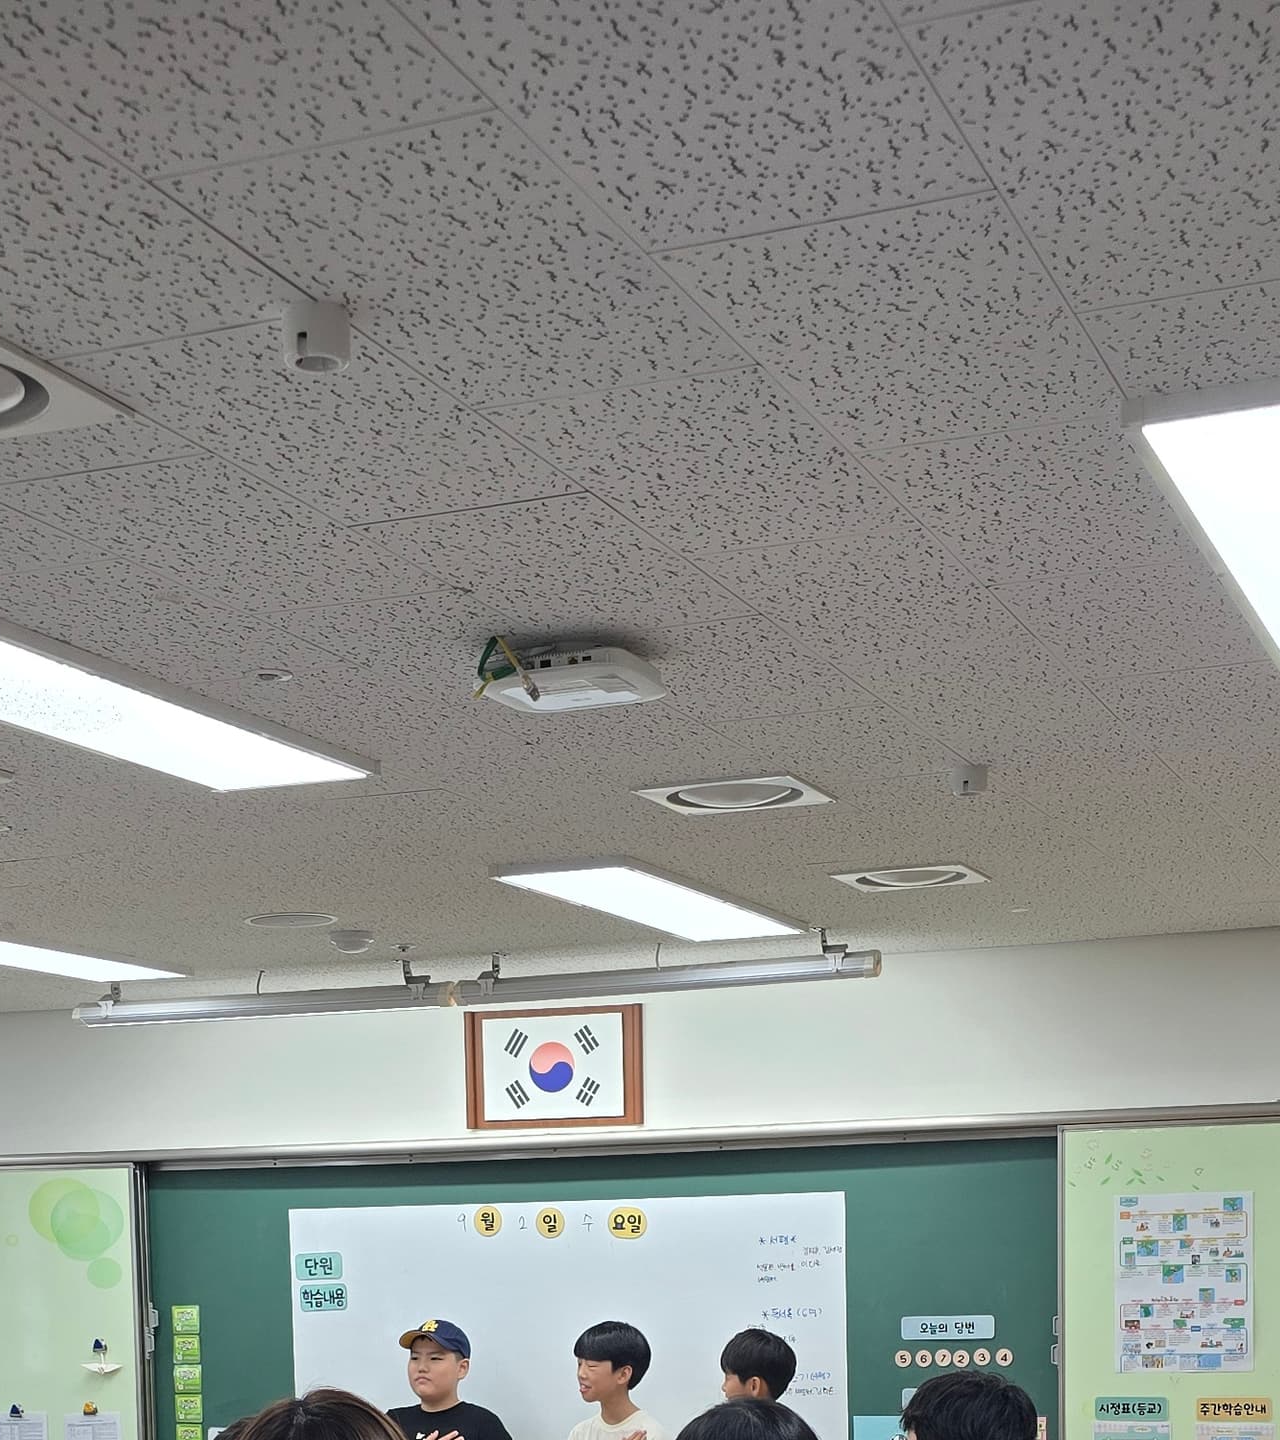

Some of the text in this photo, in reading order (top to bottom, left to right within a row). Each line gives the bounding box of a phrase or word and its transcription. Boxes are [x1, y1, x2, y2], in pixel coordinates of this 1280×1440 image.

[457, 1213, 467, 1232] 9
[481, 1212, 495, 1231] 월
[519, 1216, 527, 1230] 2
[543, 1214, 557, 1233] 일
[612, 1214, 641, 1233] 요일
[305, 1257, 332, 1276] 단원
[302, 1288, 345, 1308] 학습내용
[920, 1321, 975, 1335] 오늘의 당번
[900, 1355, 907, 1363] 5
[920, 1355, 927, 1363] 6
[958, 1355, 965, 1364] 2
[978, 1353, 986, 1361] 3
[1000, 1353, 1008, 1362] 4
[1099, 1402, 1162, 1415] 시정표(등교)
[1200, 1403, 1266, 1416] 주간학습안내
